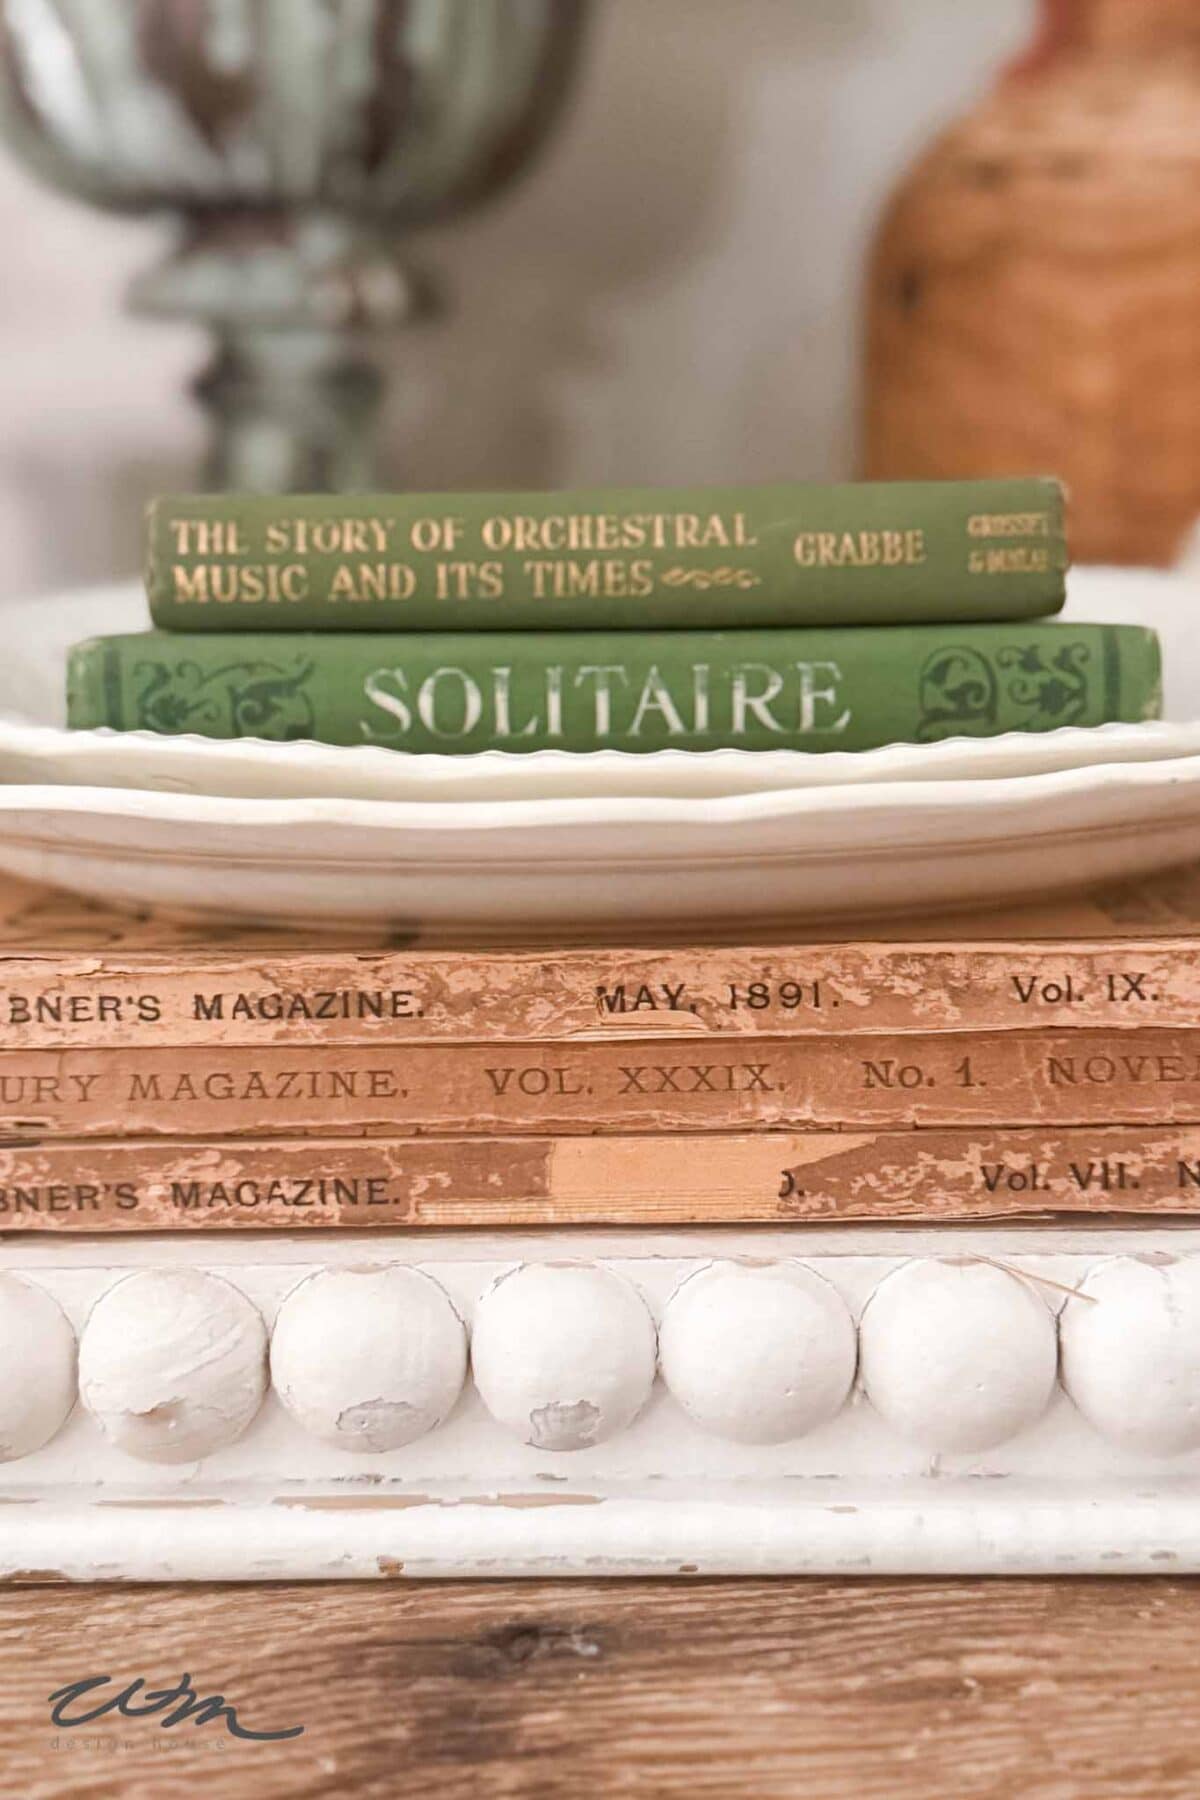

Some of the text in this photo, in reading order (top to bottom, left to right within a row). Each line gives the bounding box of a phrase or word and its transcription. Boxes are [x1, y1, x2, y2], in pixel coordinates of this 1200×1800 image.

[266, 517, 394, 554] STORY
[411, 516, 464, 552] OF
[481, 513, 757, 551] ORCHESTRAL
[794, 530, 926, 567] GRABBE
[171, 559, 653, 602] MUSIC AND ITS TIMES
[359, 660, 851, 740] SOLITAIRE
[9, 972, 1159, 1023] BNER'S MAGAZINE. MAY, 1891. Vol. IX.
[128, 1069, 409, 1101] MAGAZINE.
[485, 1067, 593, 1095] VOL.
[617, 1063, 786, 1094] XXXIX.
[862, 1059, 935, 1089] No.
[954, 1056, 988, 1087] 1.
[170, 1177, 400, 1208] MAGAZINE.
[980, 1164, 1050, 1192] Vol.
[1070, 1161, 1140, 1190] VII.
